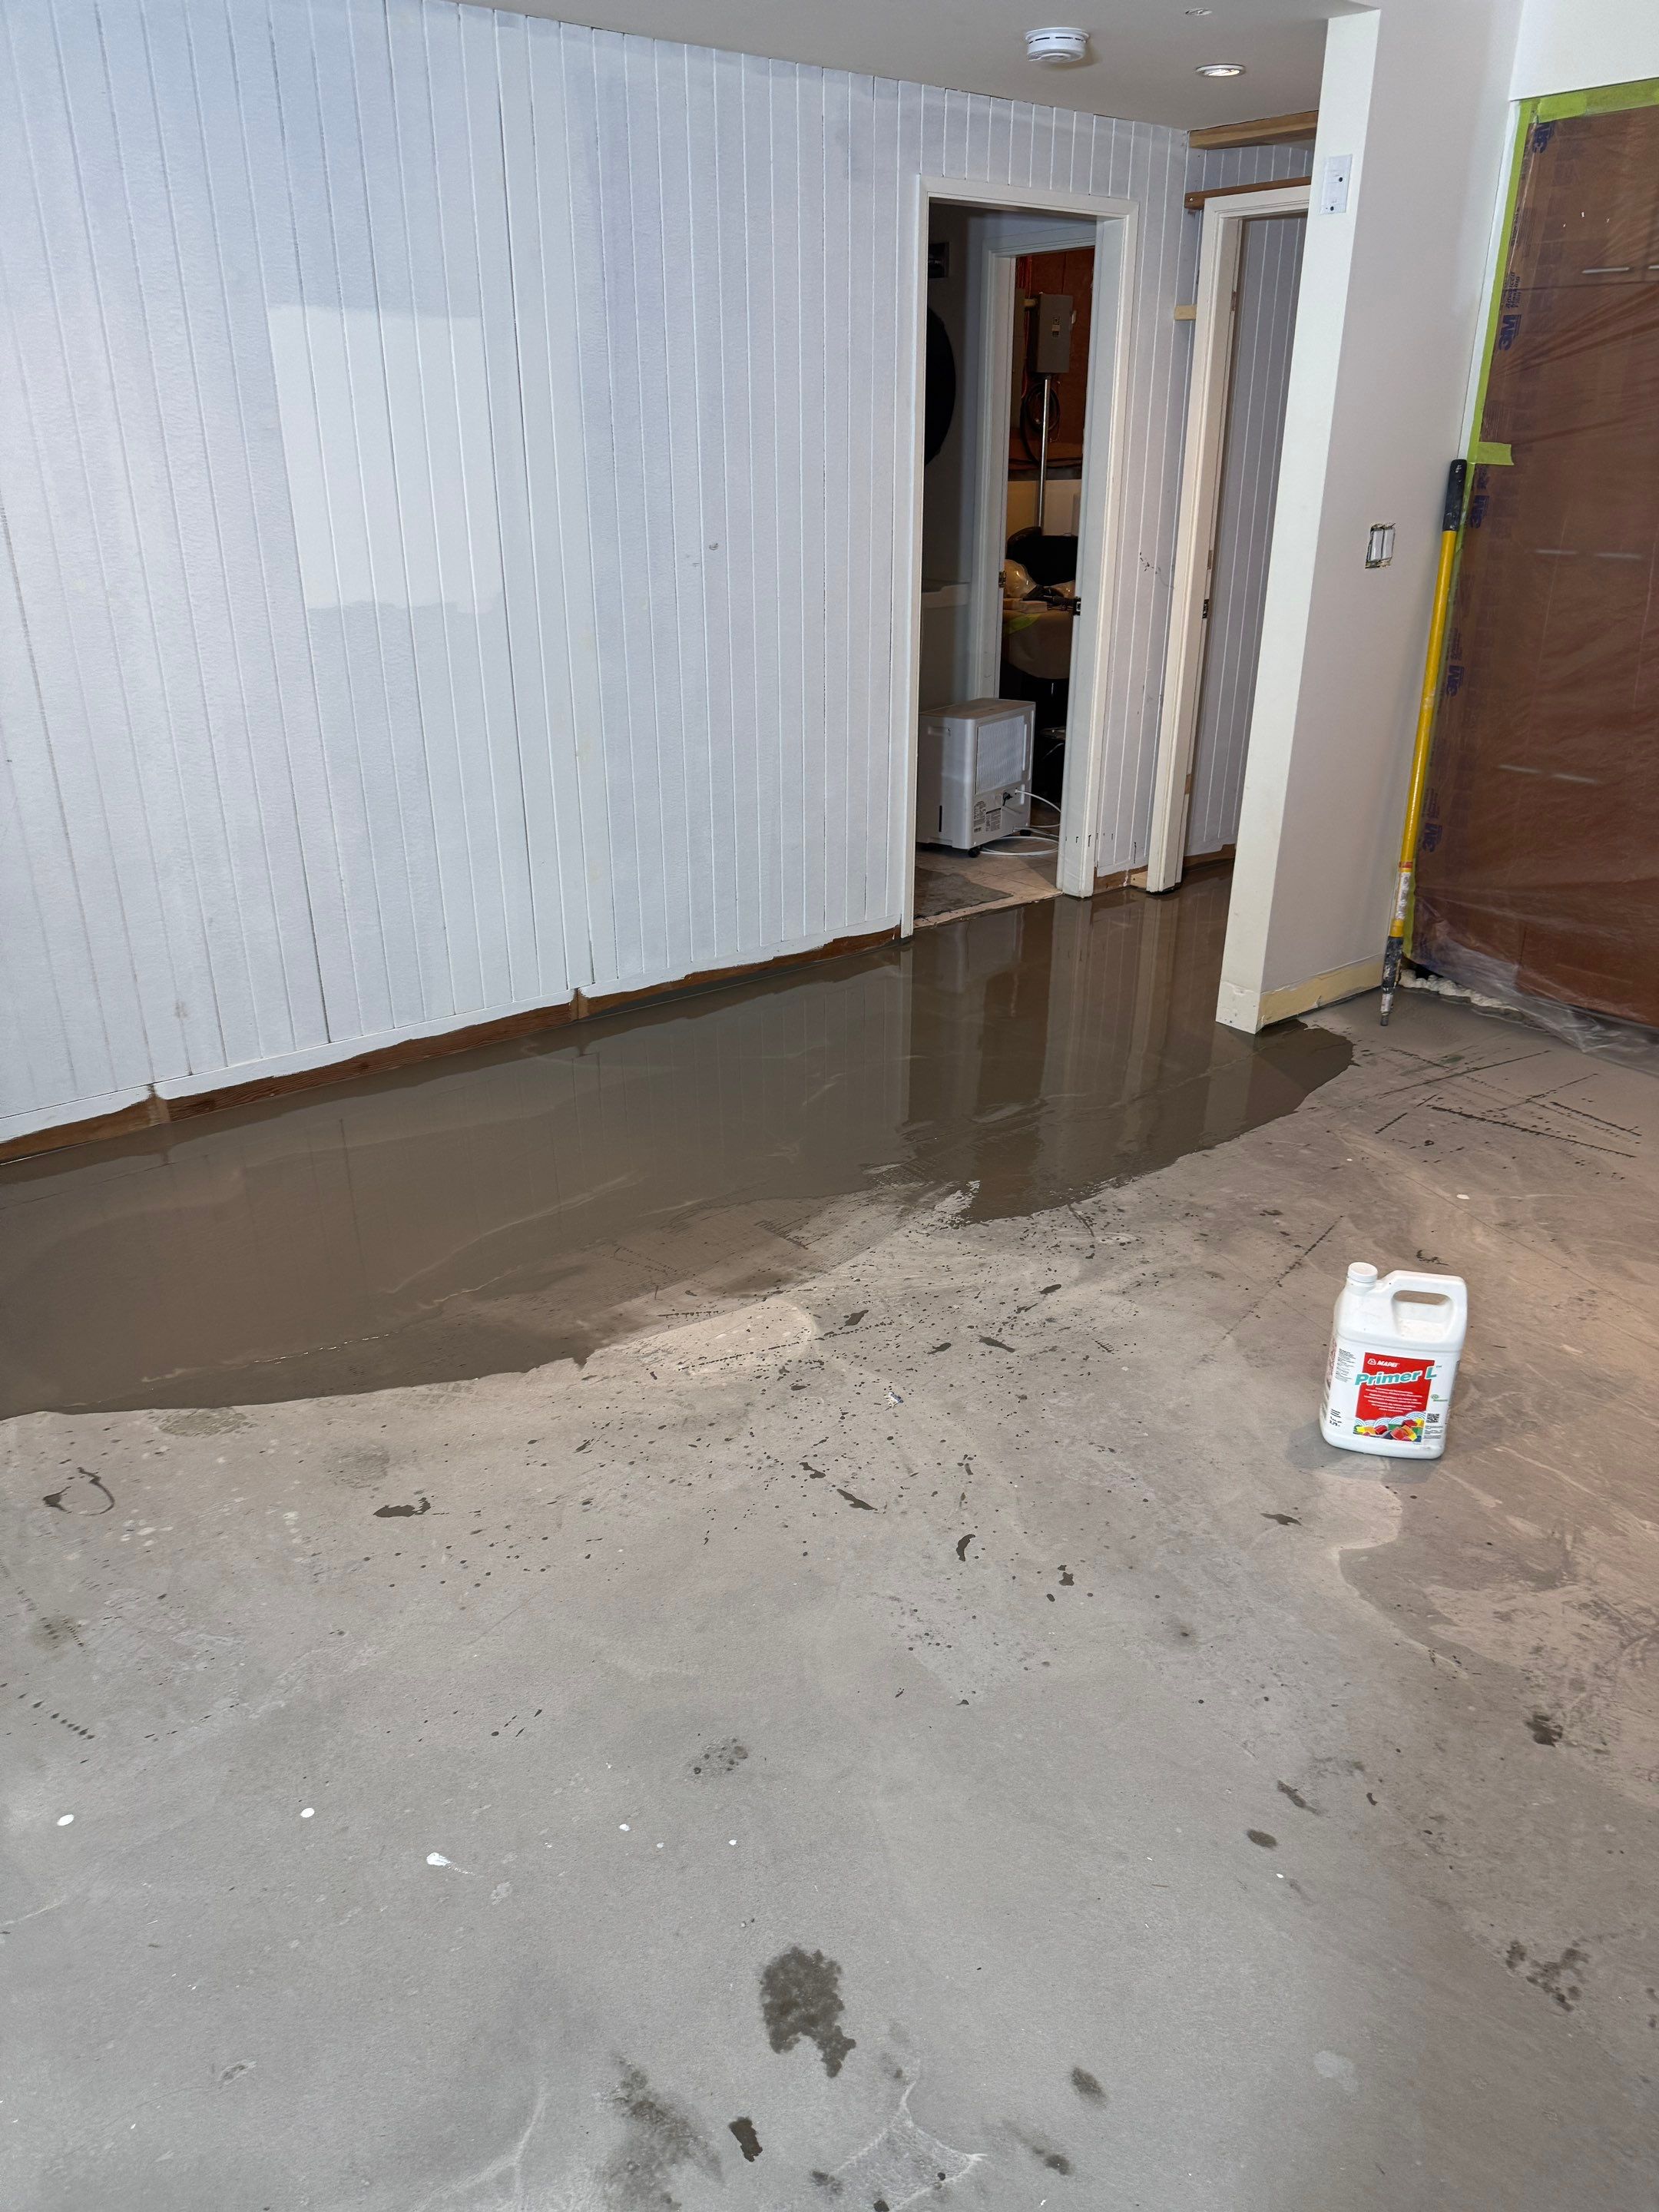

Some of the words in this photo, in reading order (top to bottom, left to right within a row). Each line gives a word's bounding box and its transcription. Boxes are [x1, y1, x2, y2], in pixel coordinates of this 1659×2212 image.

[1498, 314, 1519, 351] 3M
[1446, 665, 1461, 697] 3M
[1422, 823, 1439, 853] 3M
[1354, 1372, 1422, 1386] Primer
[1425, 1366, 1437, 1379] L
[1376, 1359, 1398, 1368] MAPEI
